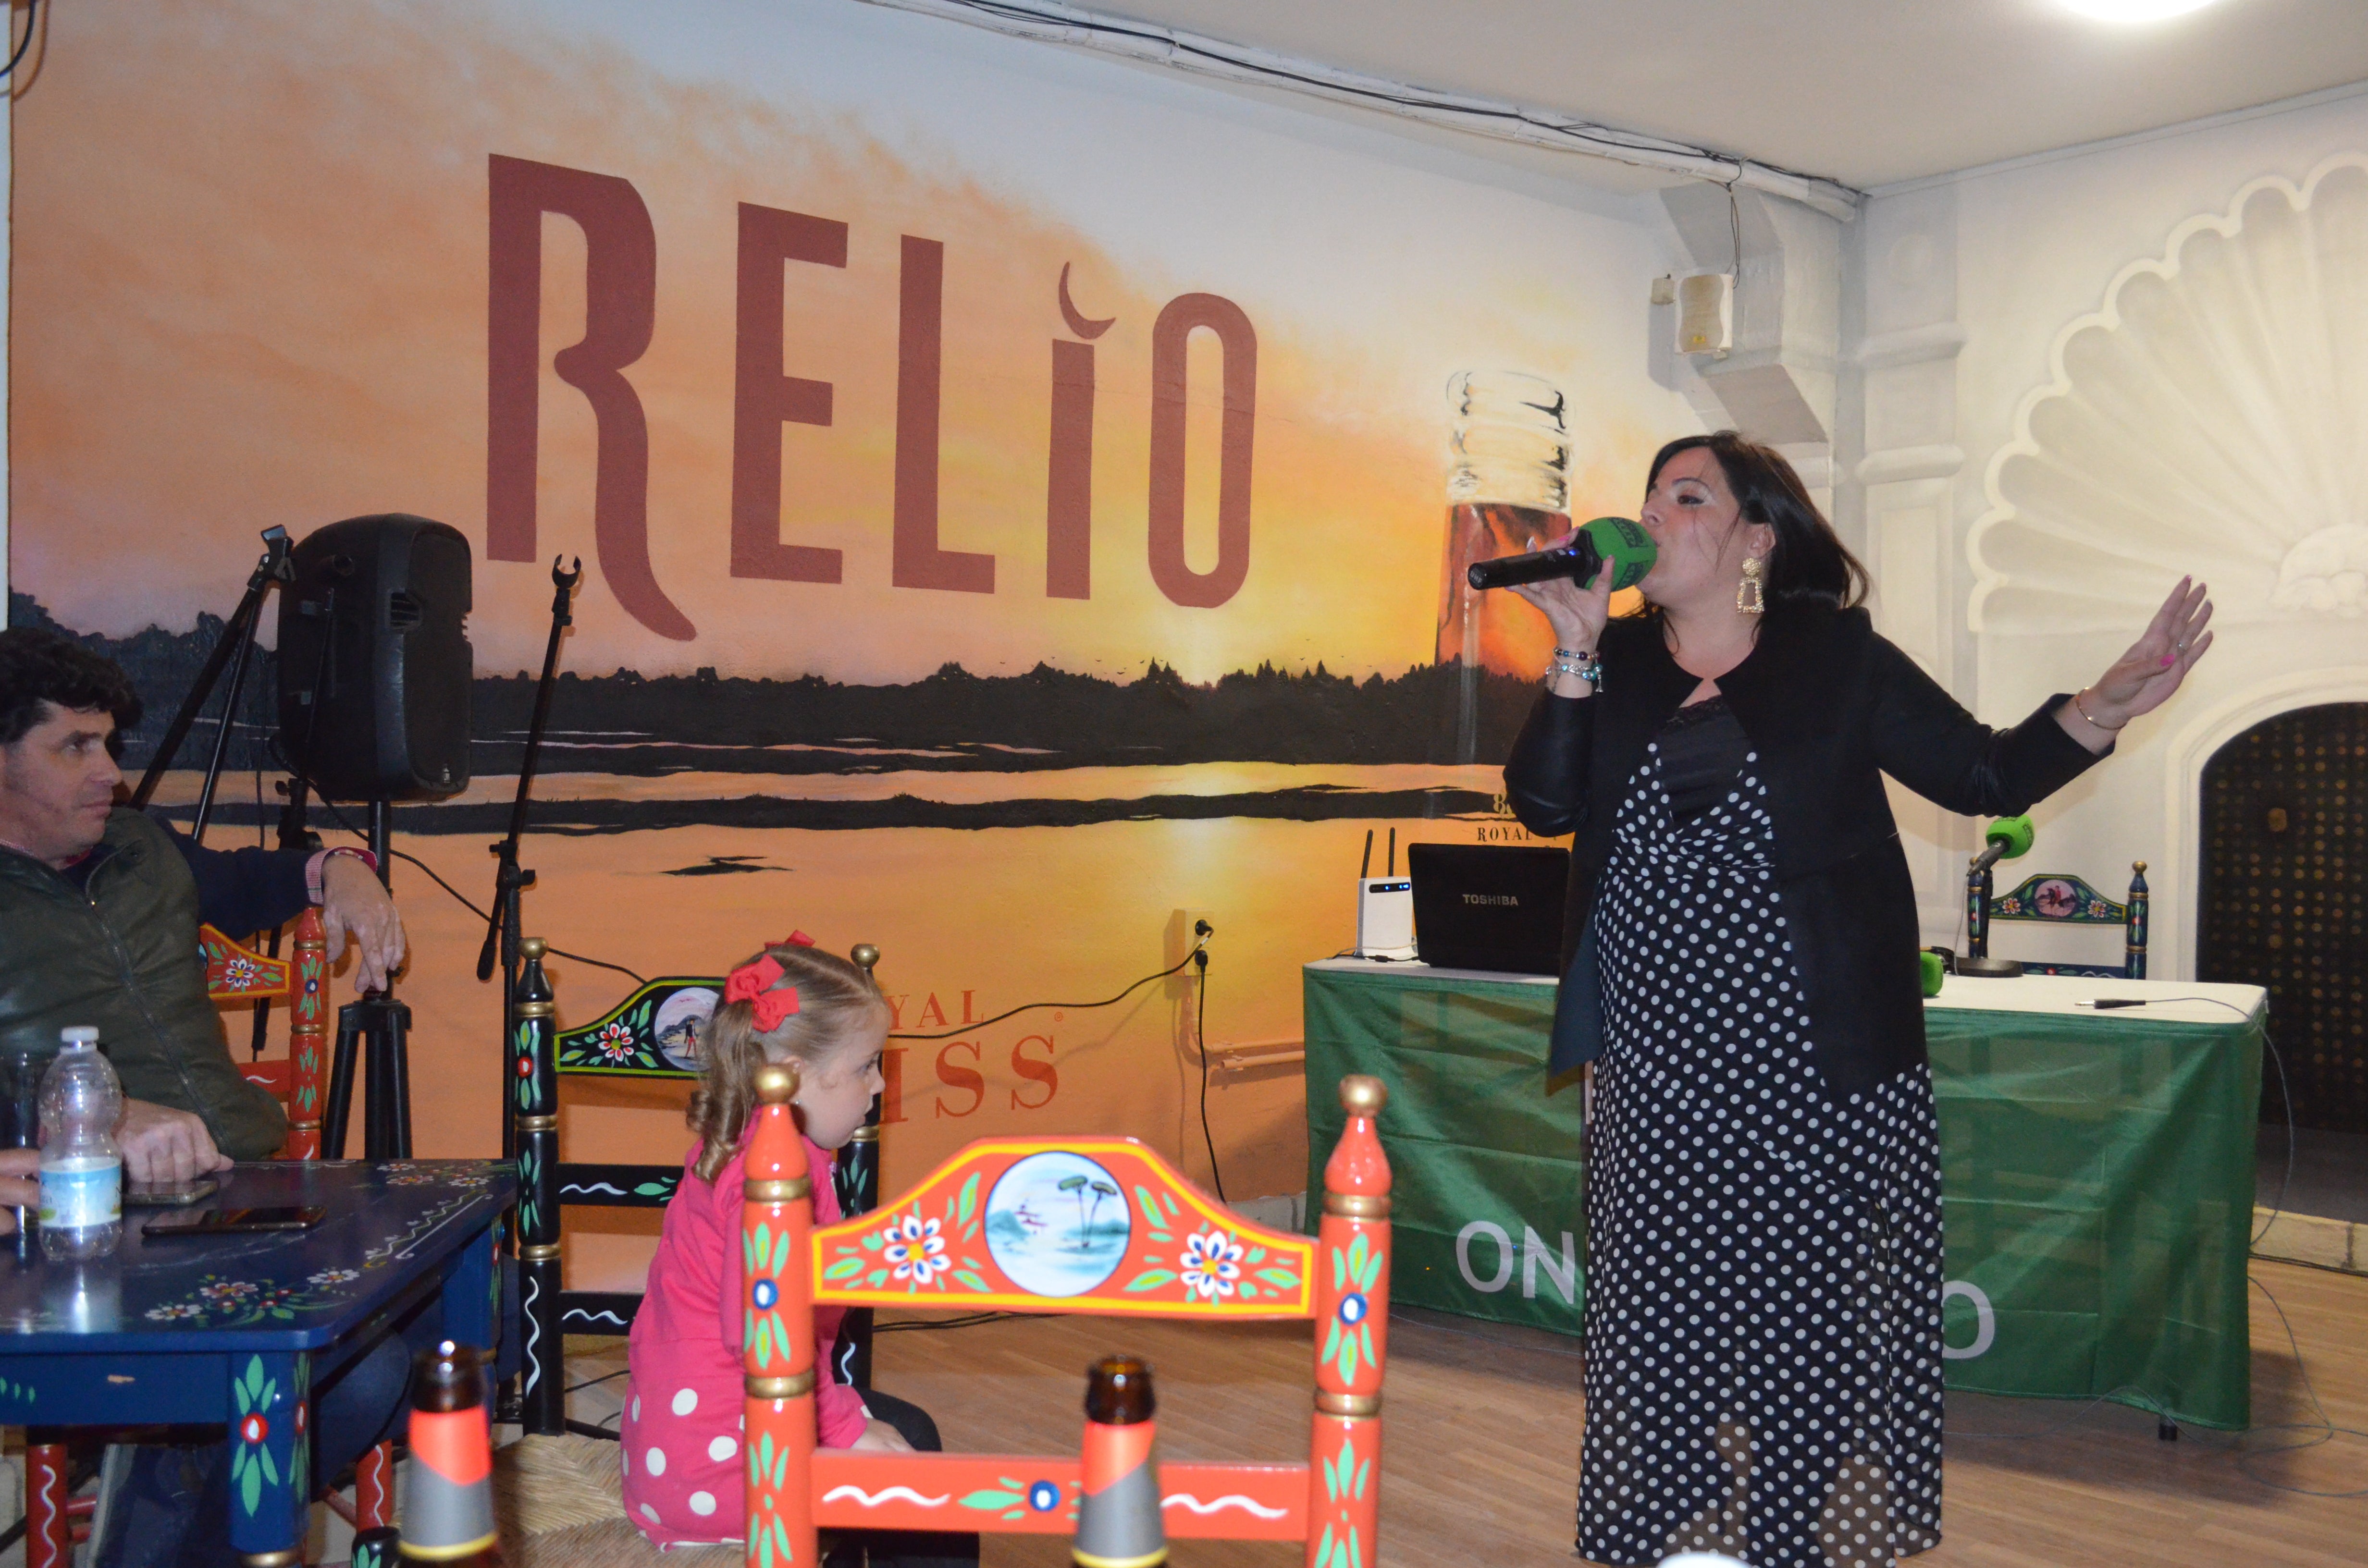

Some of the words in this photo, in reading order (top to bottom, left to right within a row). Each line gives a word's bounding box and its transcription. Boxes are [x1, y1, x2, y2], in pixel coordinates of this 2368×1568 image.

[1477, 827, 1532, 842] ROYAL
[1463, 893, 1518, 906] TOSHIBA
[889, 990, 984, 1030] YAL
[878, 1035, 1059, 1125] ISS
[1455, 1220, 1576, 1304] ON
